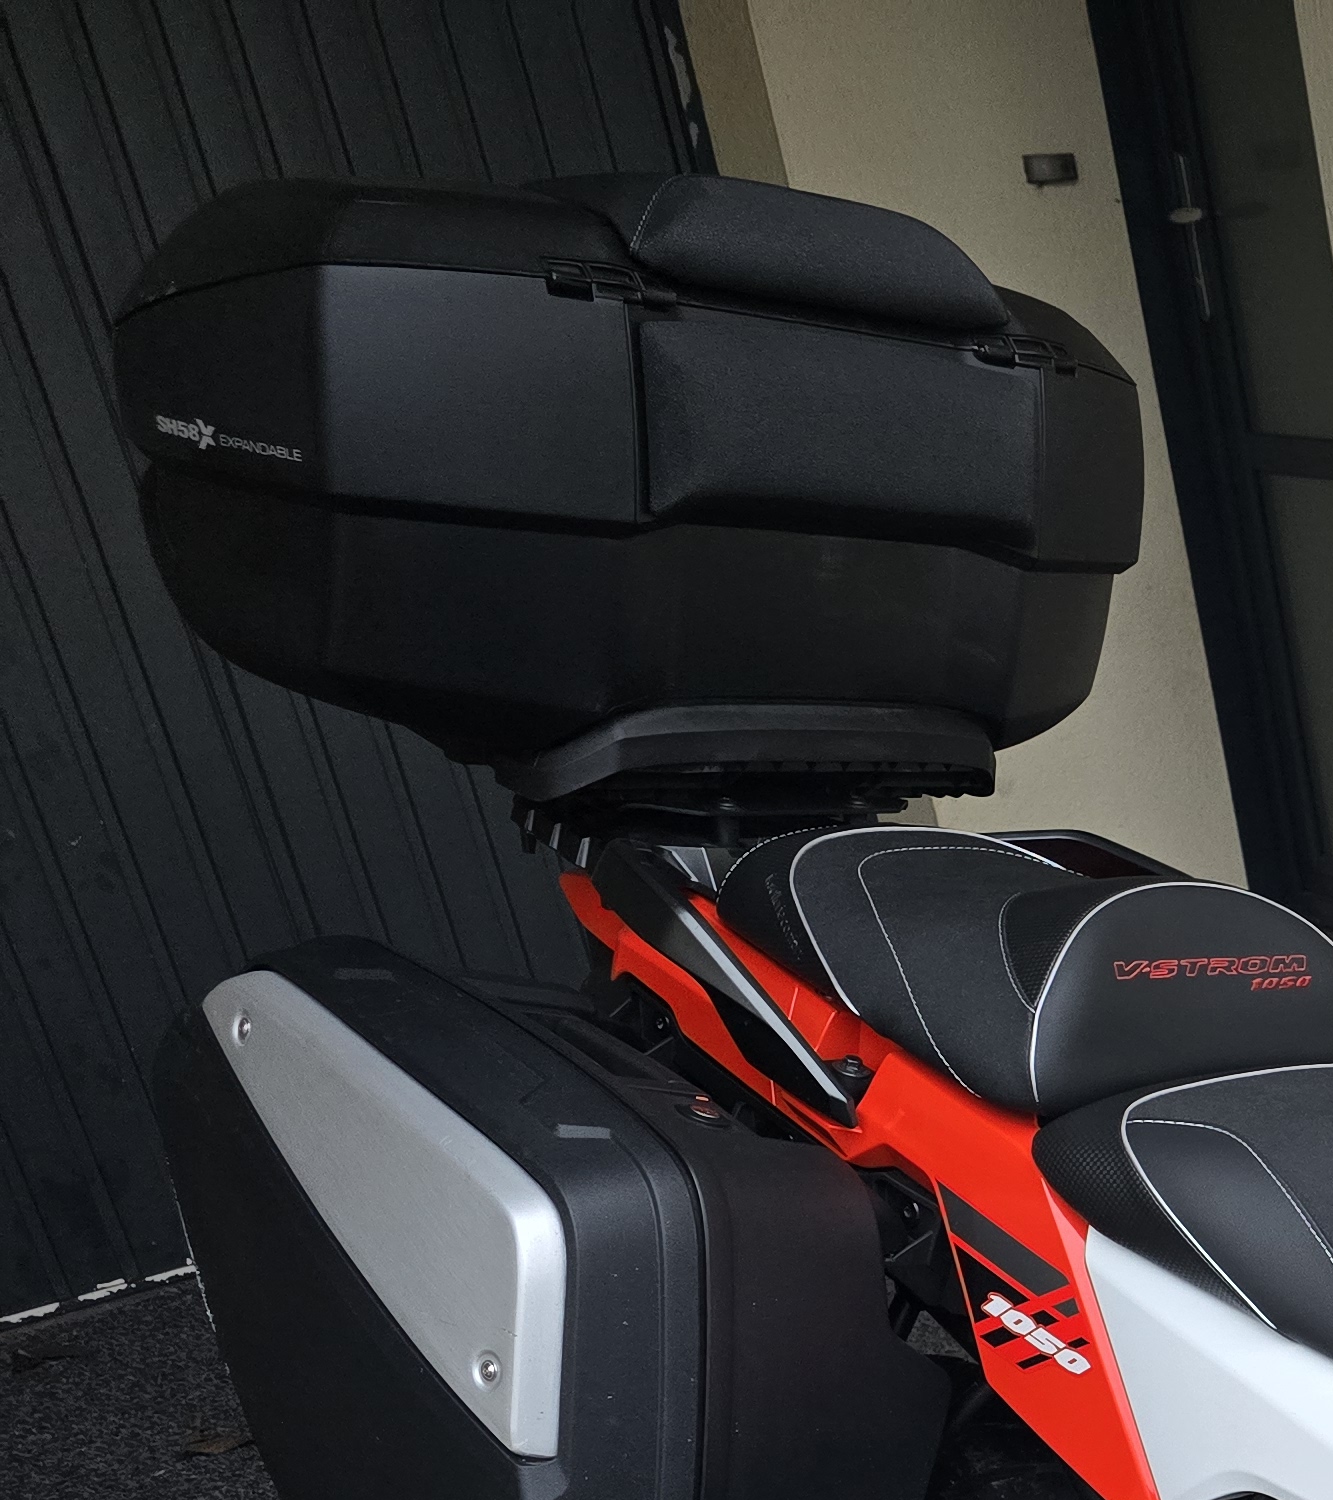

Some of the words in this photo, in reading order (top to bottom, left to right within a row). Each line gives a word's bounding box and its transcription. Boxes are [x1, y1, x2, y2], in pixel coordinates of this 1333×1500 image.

[156, 415, 216, 449] SH58X
[219, 434, 302, 461] EXPANDABLE
[1114, 953, 1307, 980] V-STROM
[1250, 975, 1311, 991] 1050
[980, 1291, 1091, 1376] 1050
